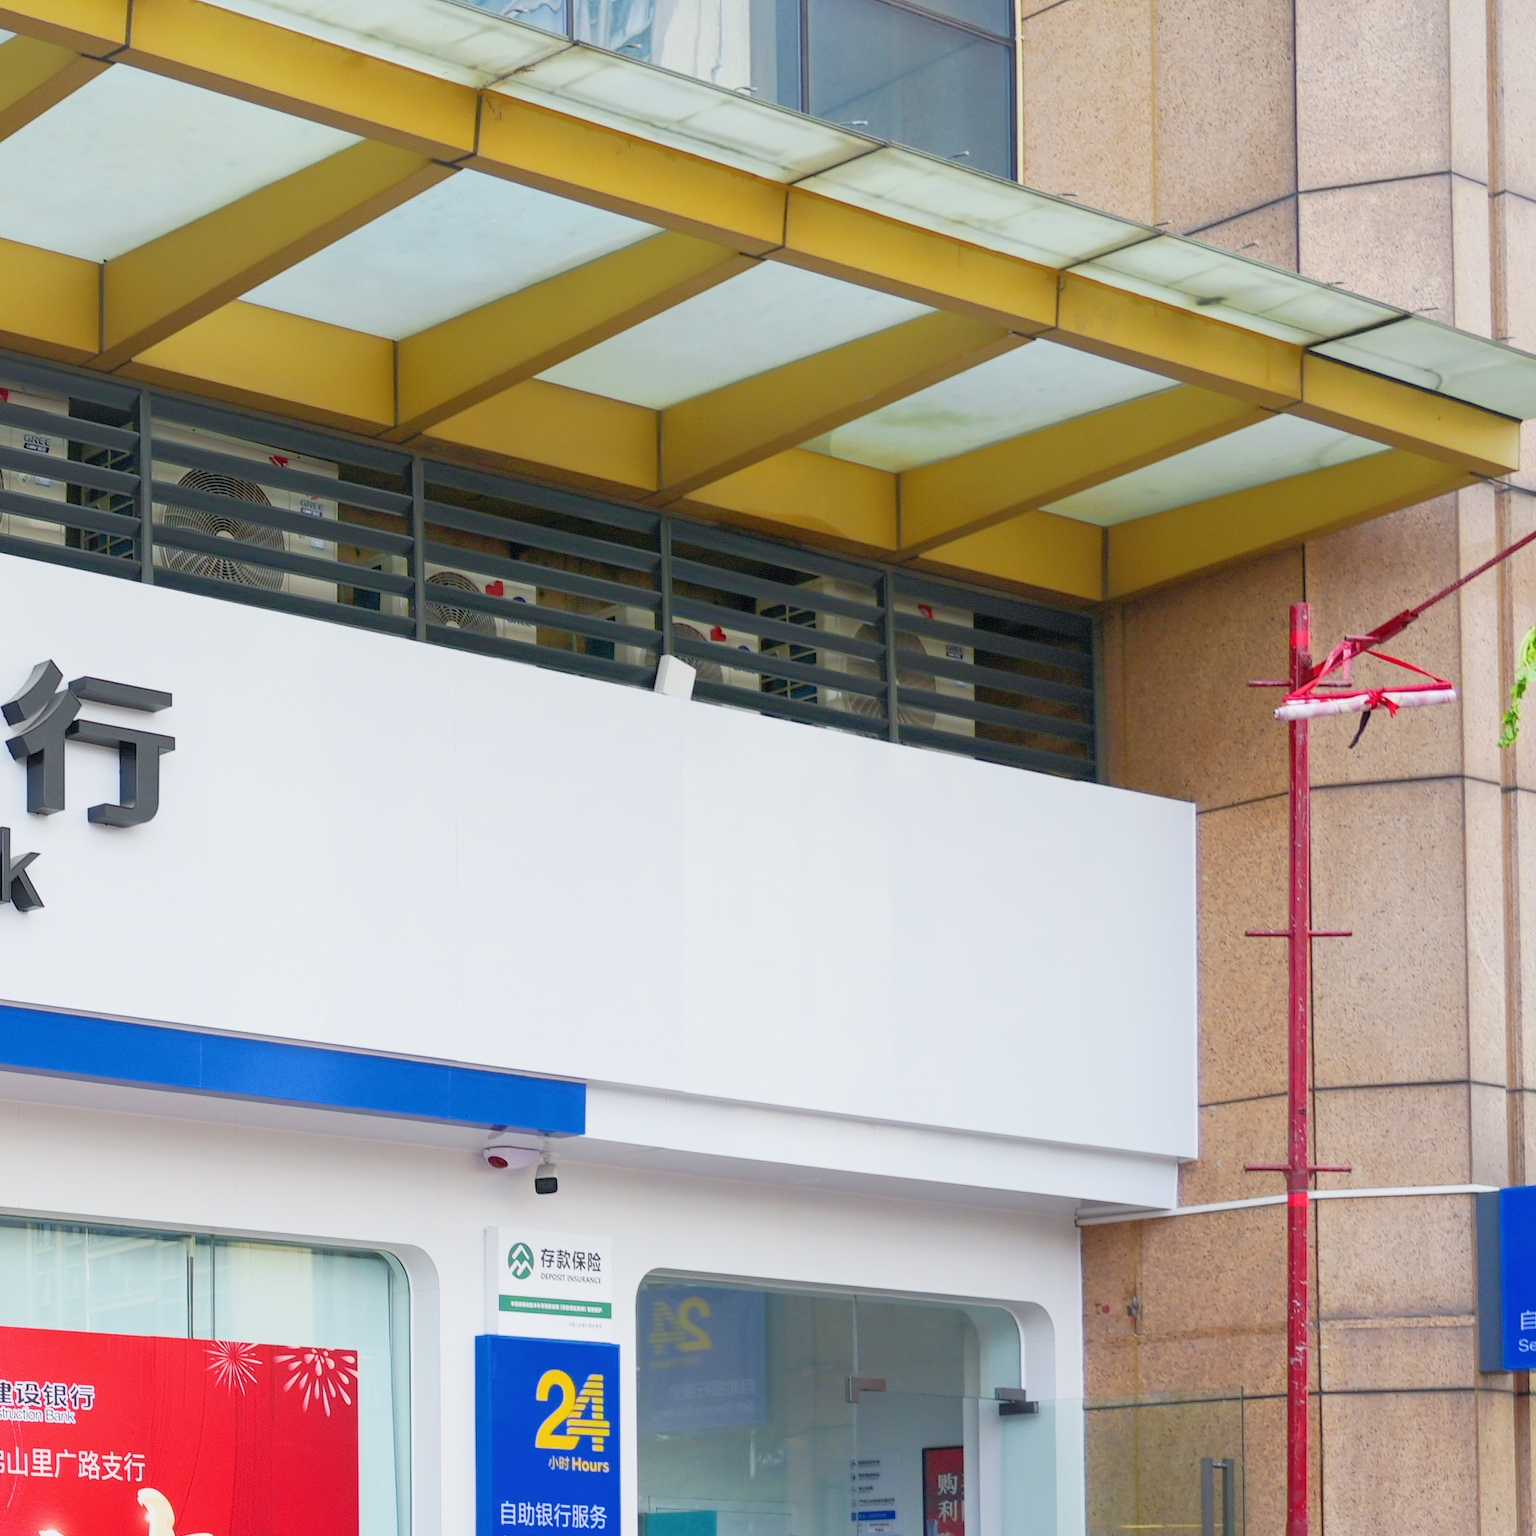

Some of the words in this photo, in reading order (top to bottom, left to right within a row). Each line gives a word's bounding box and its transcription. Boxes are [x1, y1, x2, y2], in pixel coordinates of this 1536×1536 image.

[24, 434, 51, 447] GREE
[300, 500, 324, 511] GREE
[541, 1248, 601, 1272] 存款保险
[541, 1272, 566, 1281] DEPOSIT
[567, 1274, 602, 1285] INSURANCE
[45, 1407, 76, 1423] Bank
[535, 1369, 610, 1452] 24
[548, 1455, 570, 1470] 小时
[572, 1457, 610, 1473] Hours
[500, 1500, 608, 1530] 自助银行服务
